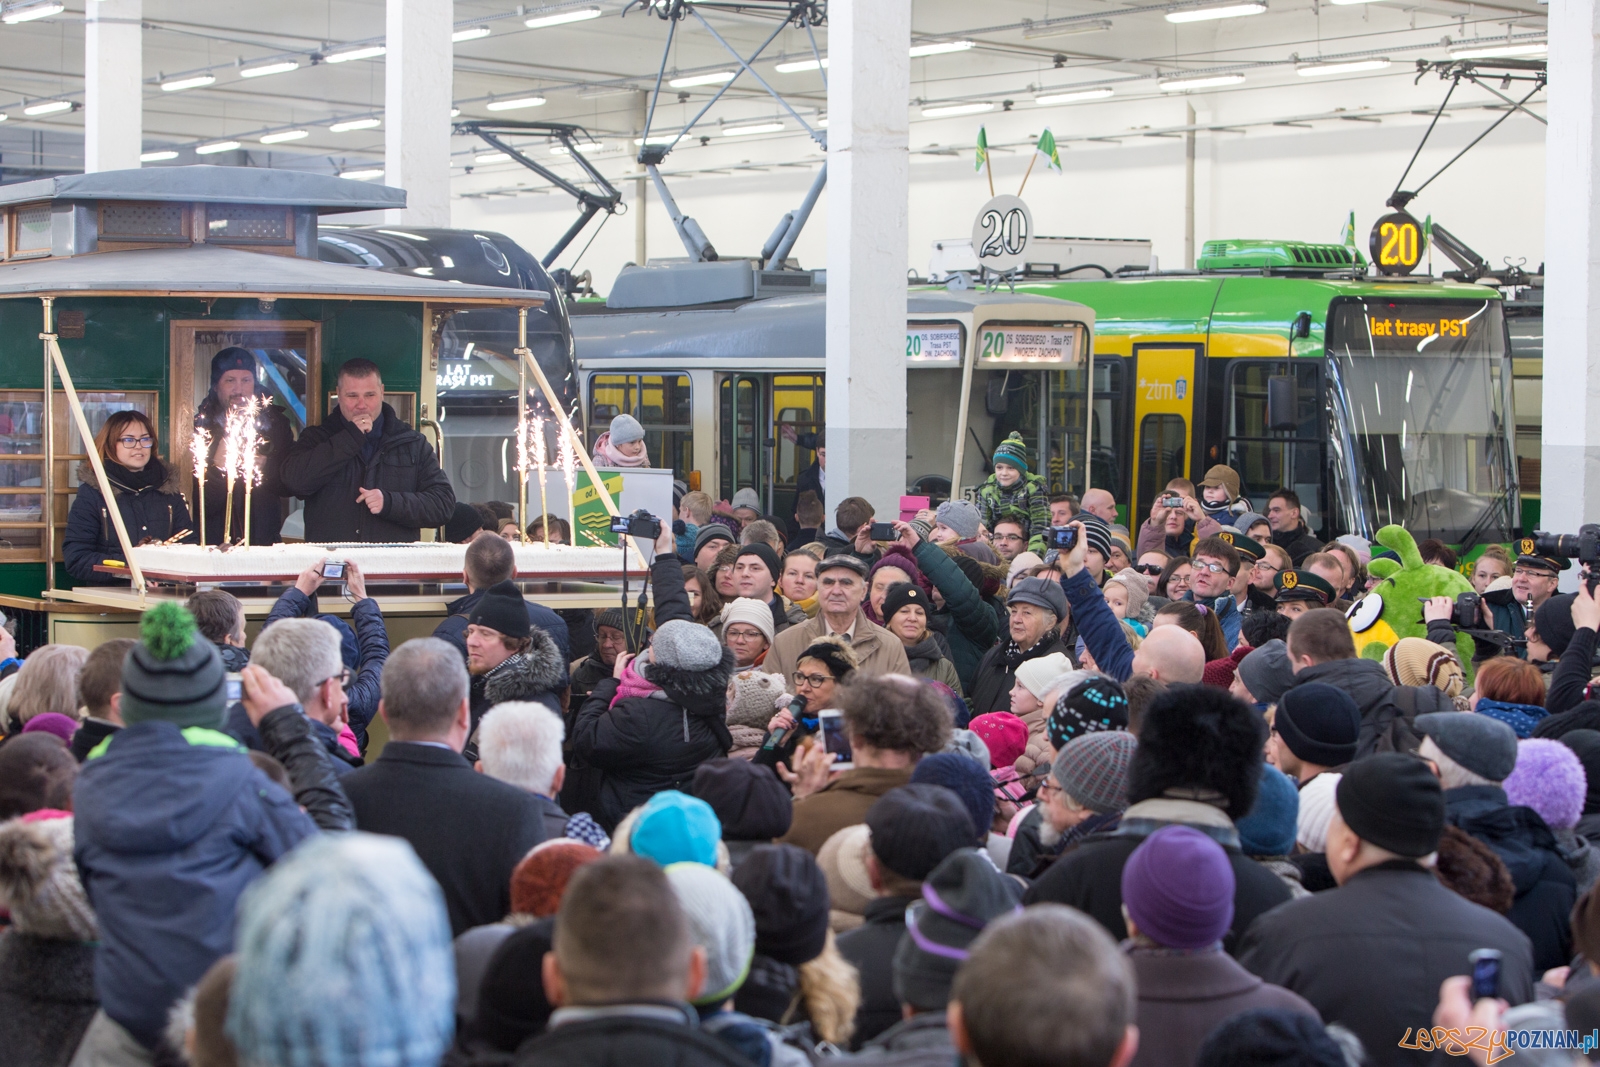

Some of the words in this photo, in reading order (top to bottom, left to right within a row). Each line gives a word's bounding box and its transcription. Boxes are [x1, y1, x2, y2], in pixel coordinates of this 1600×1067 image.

[979, 207, 1028, 258] 20
[1380, 222, 1418, 265] 20
[1370, 316, 1392, 336] lat
[1395, 318, 1436, 338] trasy
[1439, 318, 1470, 337] PST
[906, 334, 921, 357] 20
[930, 341, 942, 349] Trasa
[943, 341, 952, 349] PST
[982, 331, 1005, 358] 20
[1015, 333, 1047, 345] SOBIESKIEGO
[1051, 335, 1063, 346] Trasa
[1063, 335, 1073, 346] PST
[934, 349, 958, 357] ZACHODNI
[1013, 346, 1038, 357] DWORZEC
[1038, 347, 1062, 358] ZACHODNI
[446, 364, 472, 375] LAT
[436, 374, 468, 386] RASY
[469, 374, 494, 387] PST
[1146, 379, 1173, 400] ztm
[585, 488, 593, 498] od
